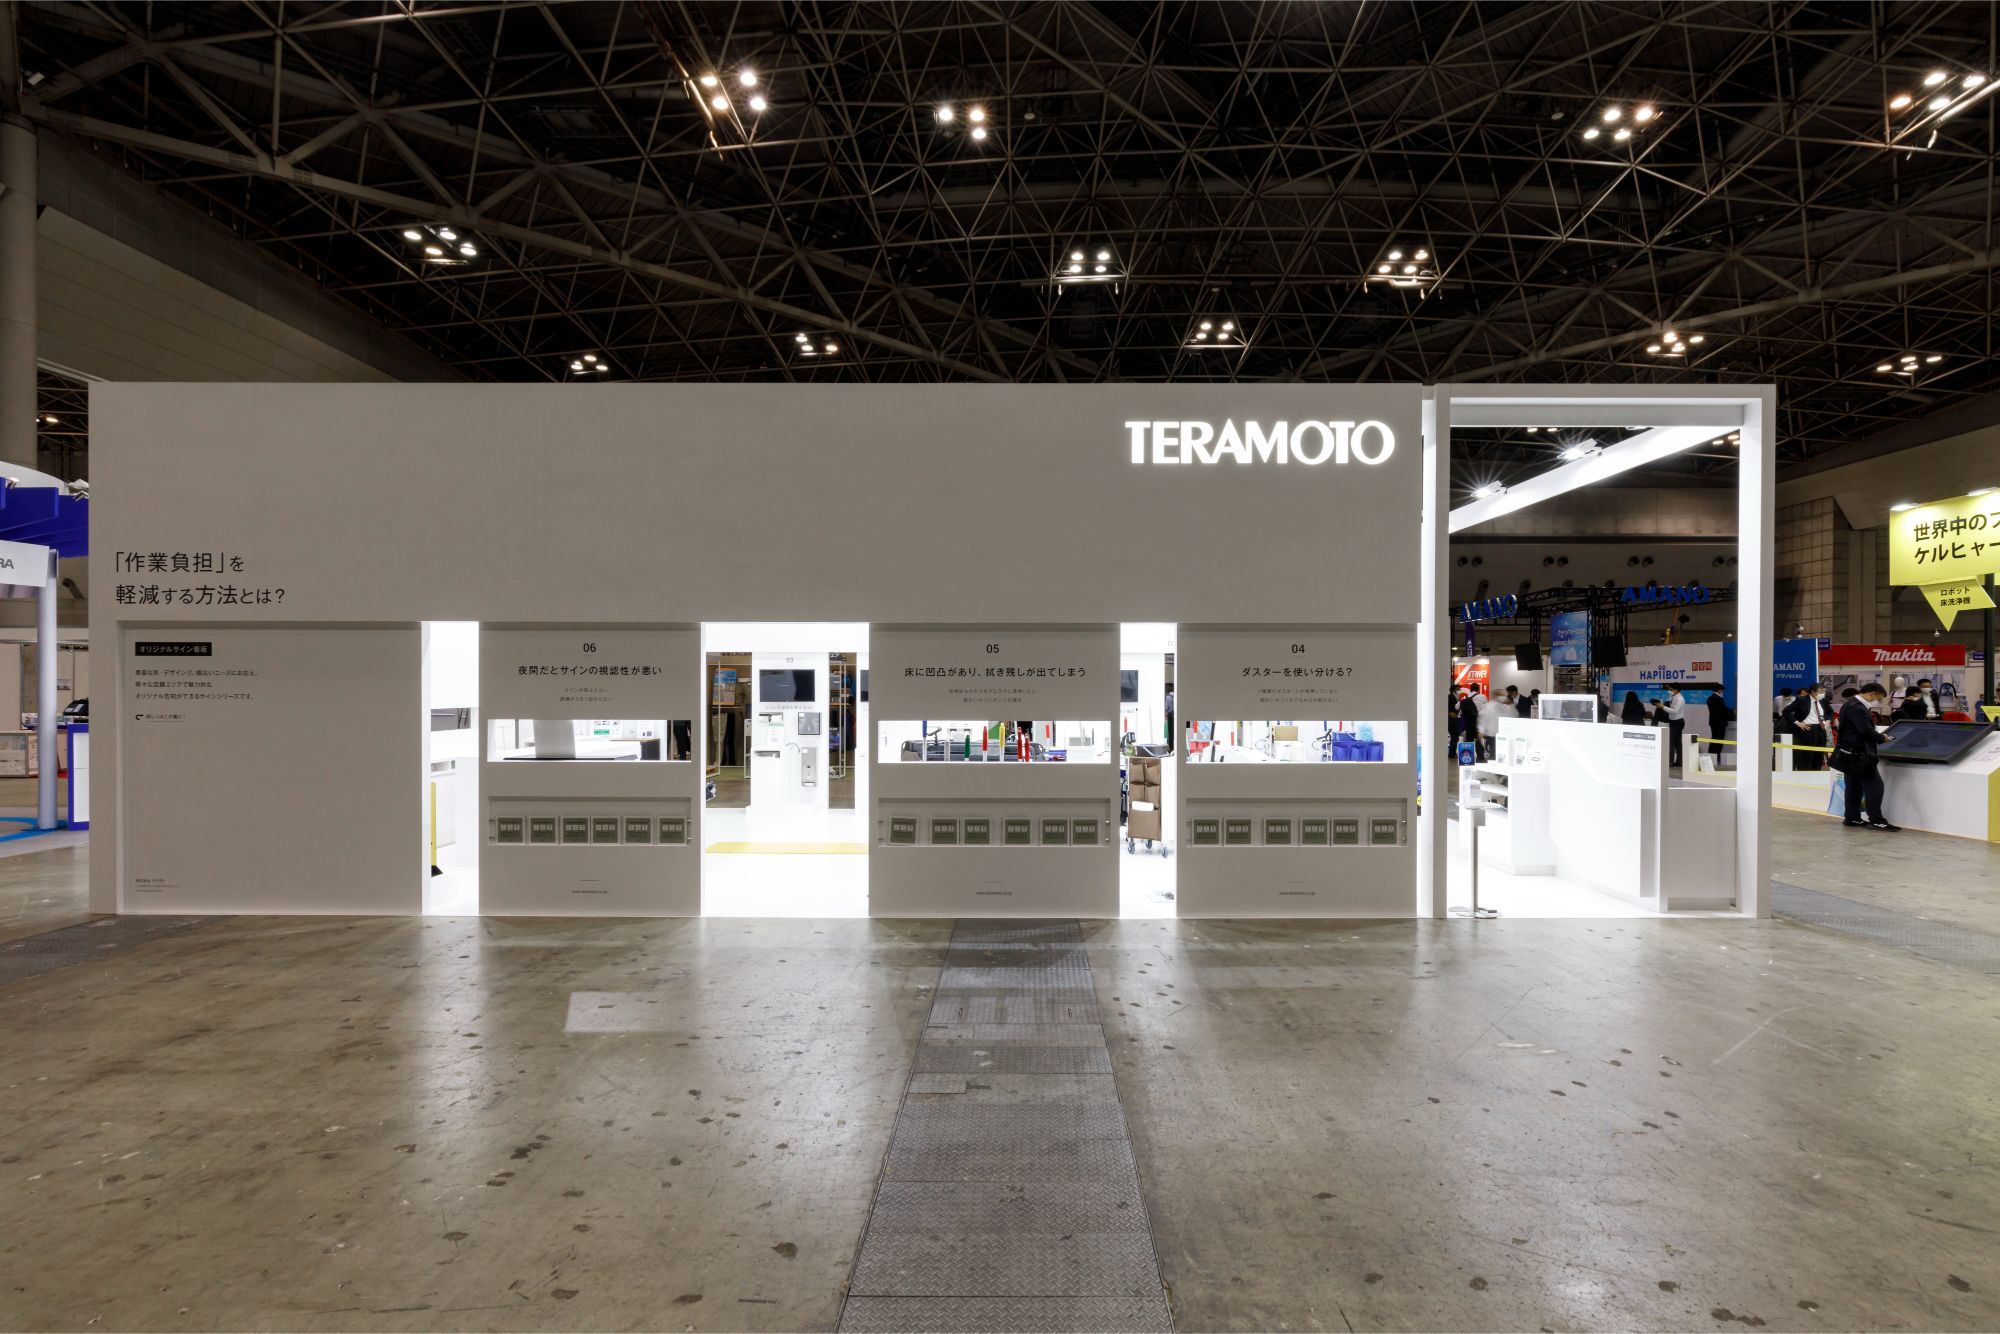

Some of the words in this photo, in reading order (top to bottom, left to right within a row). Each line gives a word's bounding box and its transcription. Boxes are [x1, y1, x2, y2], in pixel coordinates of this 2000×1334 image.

[1125, 418, 1395, 465] TERAMOTO
[116, 552, 244, 573] 「作業負担」を
[116, 584, 285, 605] 軽減する方法とは？
[1621, 585, 1710, 604] AMANO
[1940, 586, 1970, 596] ロボット
[1940, 597, 1971, 607] 床洗浄機
[582, 643, 597, 653] 06
[985, 644, 1000, 654] 05
[1291, 644, 1305, 654] 04
[518, 665, 662, 676] 夜間だとサインの視認性が悪い
[904, 667, 1087, 677] 床に凹凸があり、拭き残しが出てしまう
[1242, 667, 1353, 677] ダスターを使い分ける？
